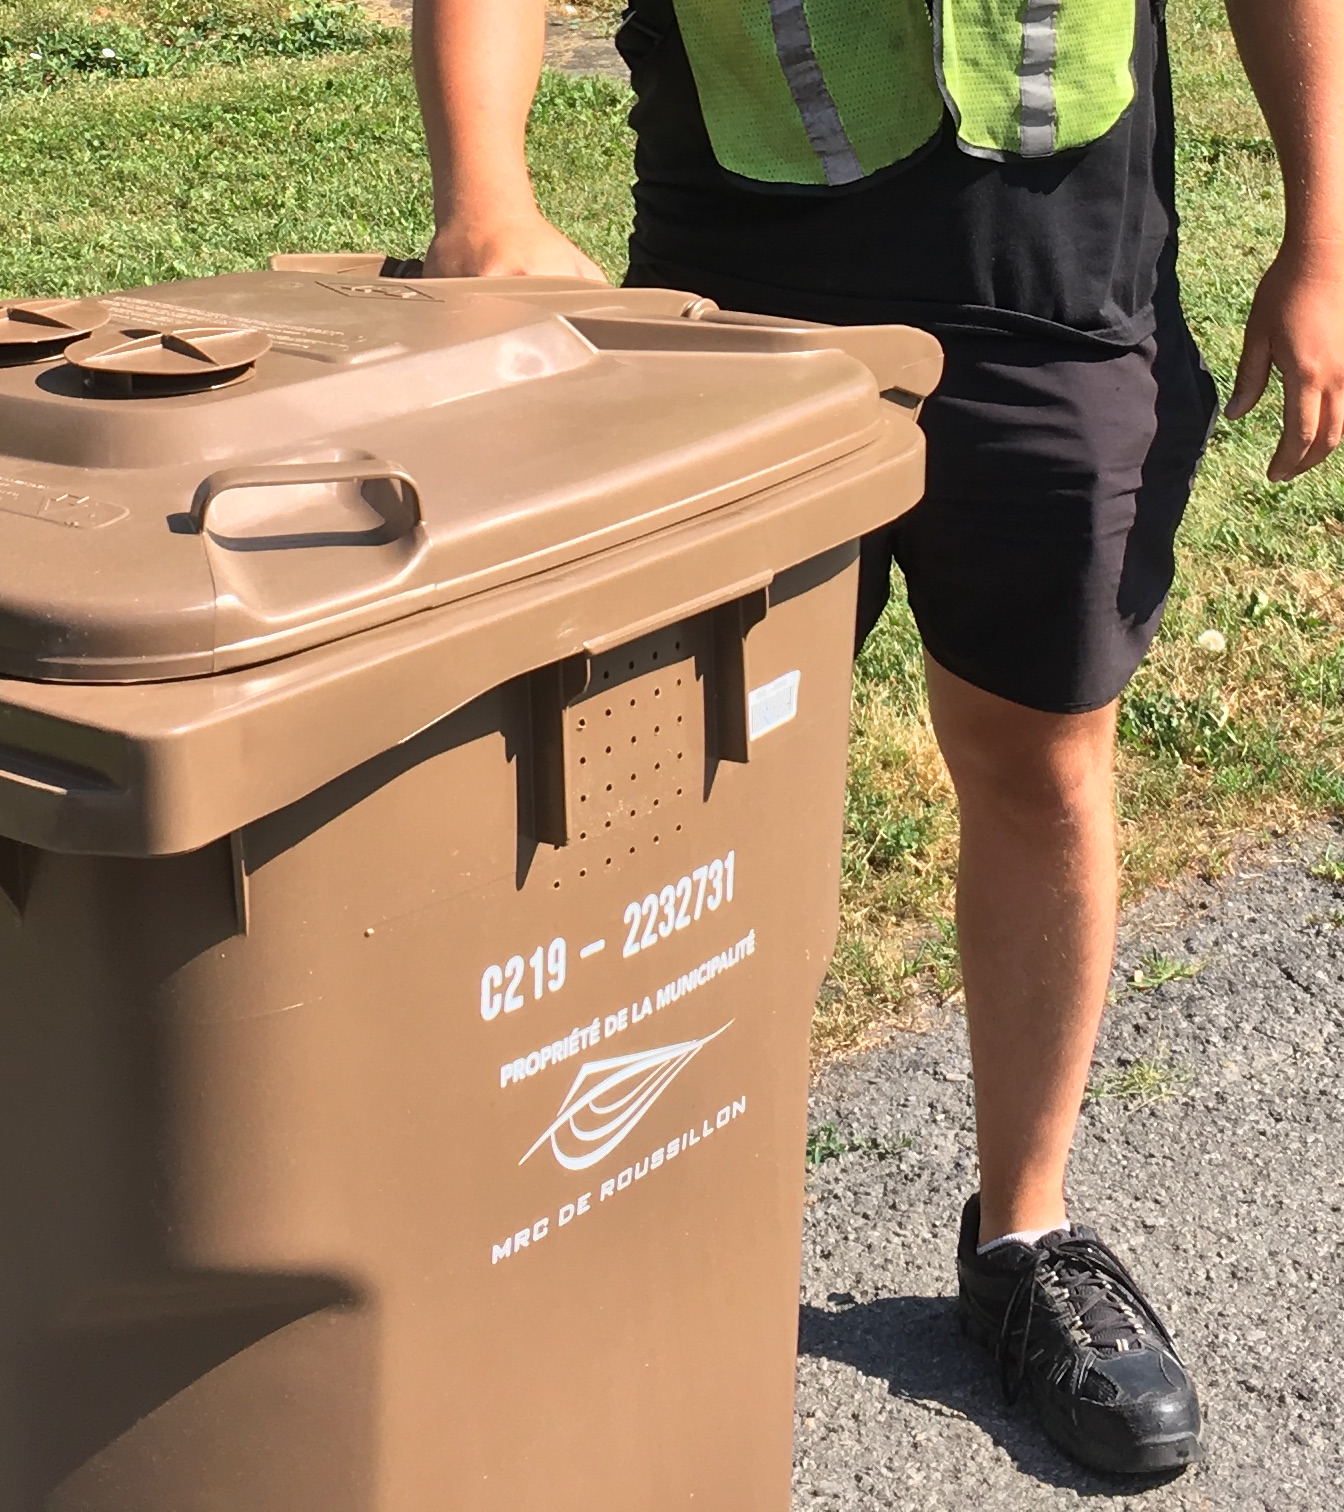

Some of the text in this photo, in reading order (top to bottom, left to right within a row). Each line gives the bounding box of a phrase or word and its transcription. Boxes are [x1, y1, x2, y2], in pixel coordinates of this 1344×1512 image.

[480, 937, 566, 1021] C219
[623, 850, 735, 958] 2232731
[500, 929, 756, 1088] PROPRIÉTÉ DE LA MUNICIPALITÉ
[491, 1095, 748, 1264] MRC DE ROUSSILLON
